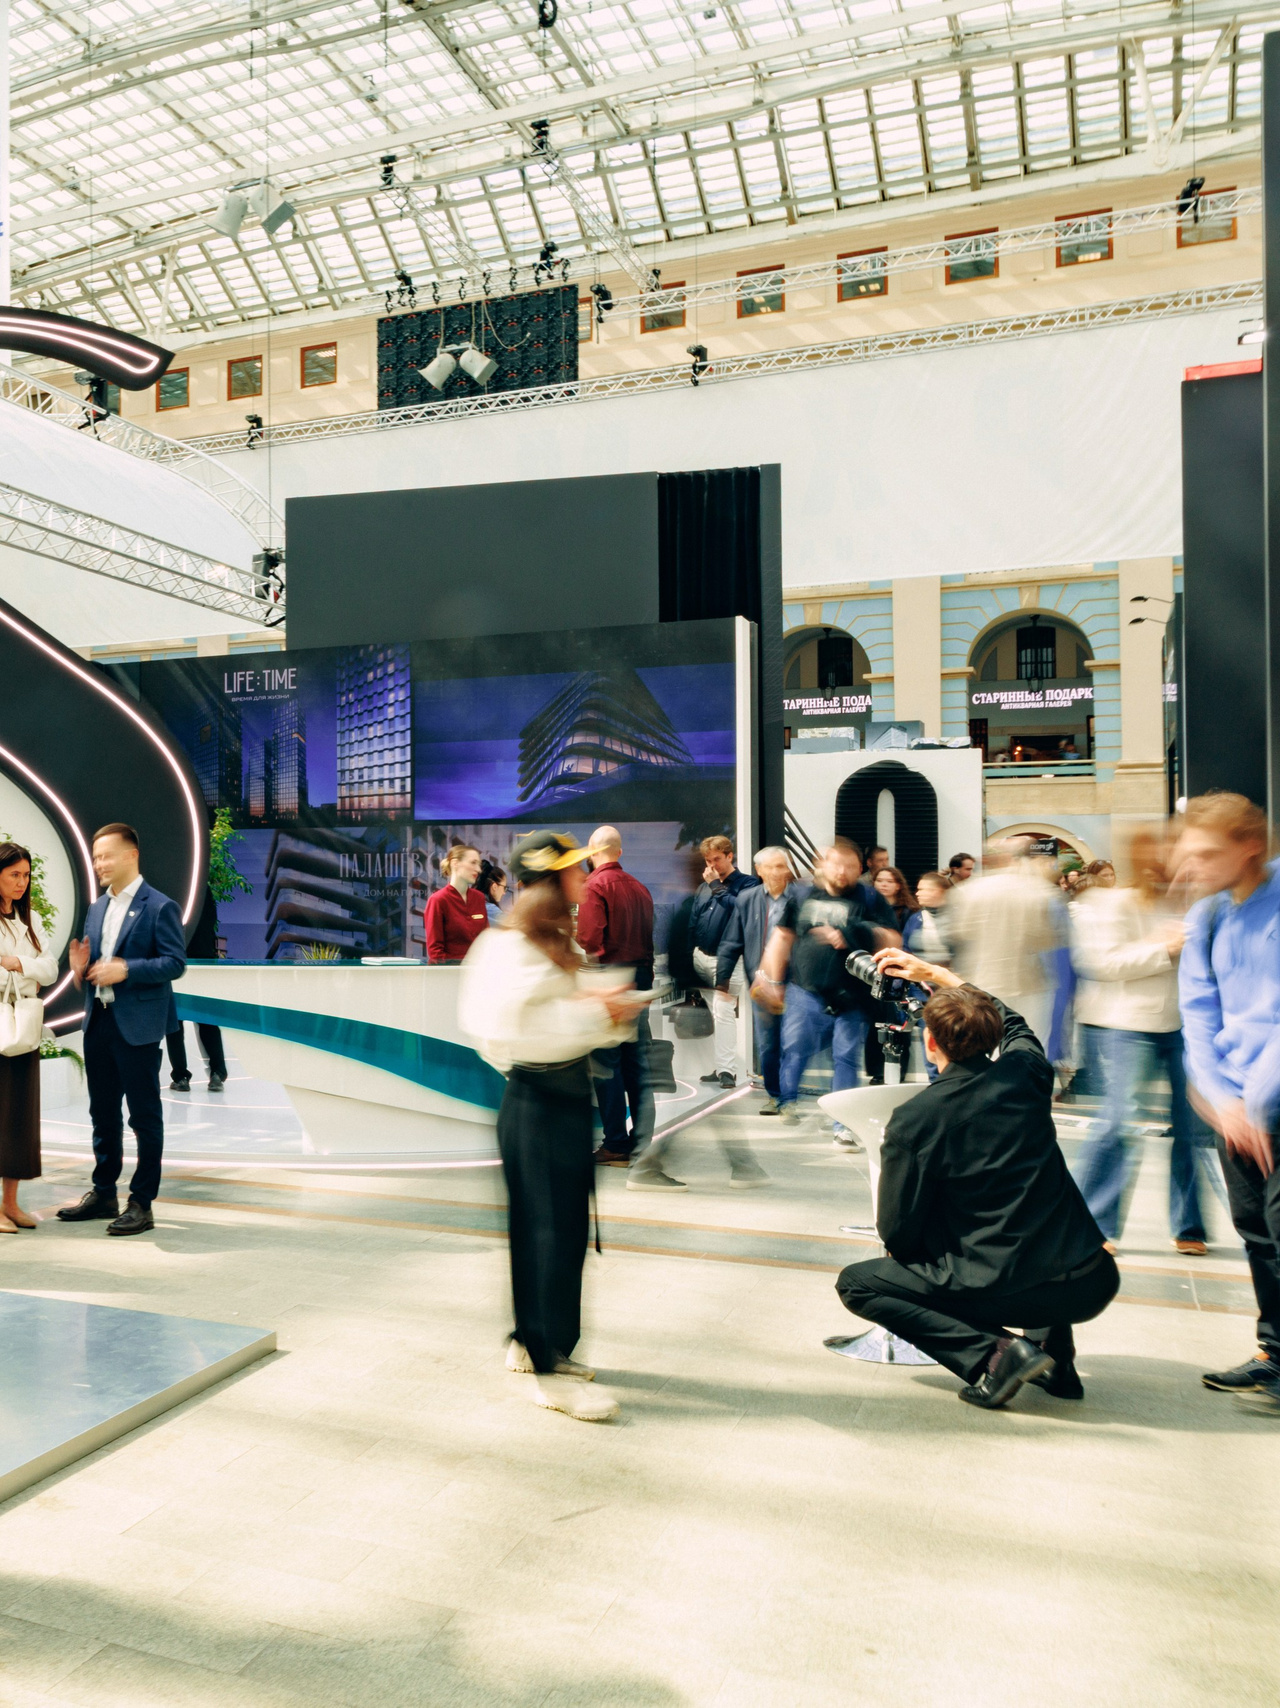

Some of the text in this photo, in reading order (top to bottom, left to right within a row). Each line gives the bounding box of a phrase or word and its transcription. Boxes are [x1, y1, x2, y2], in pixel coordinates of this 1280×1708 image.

[782, 694, 873, 710] ТАРИННЫЕ ПОДА
[1045, 687, 1093, 702] ПОДАРК
